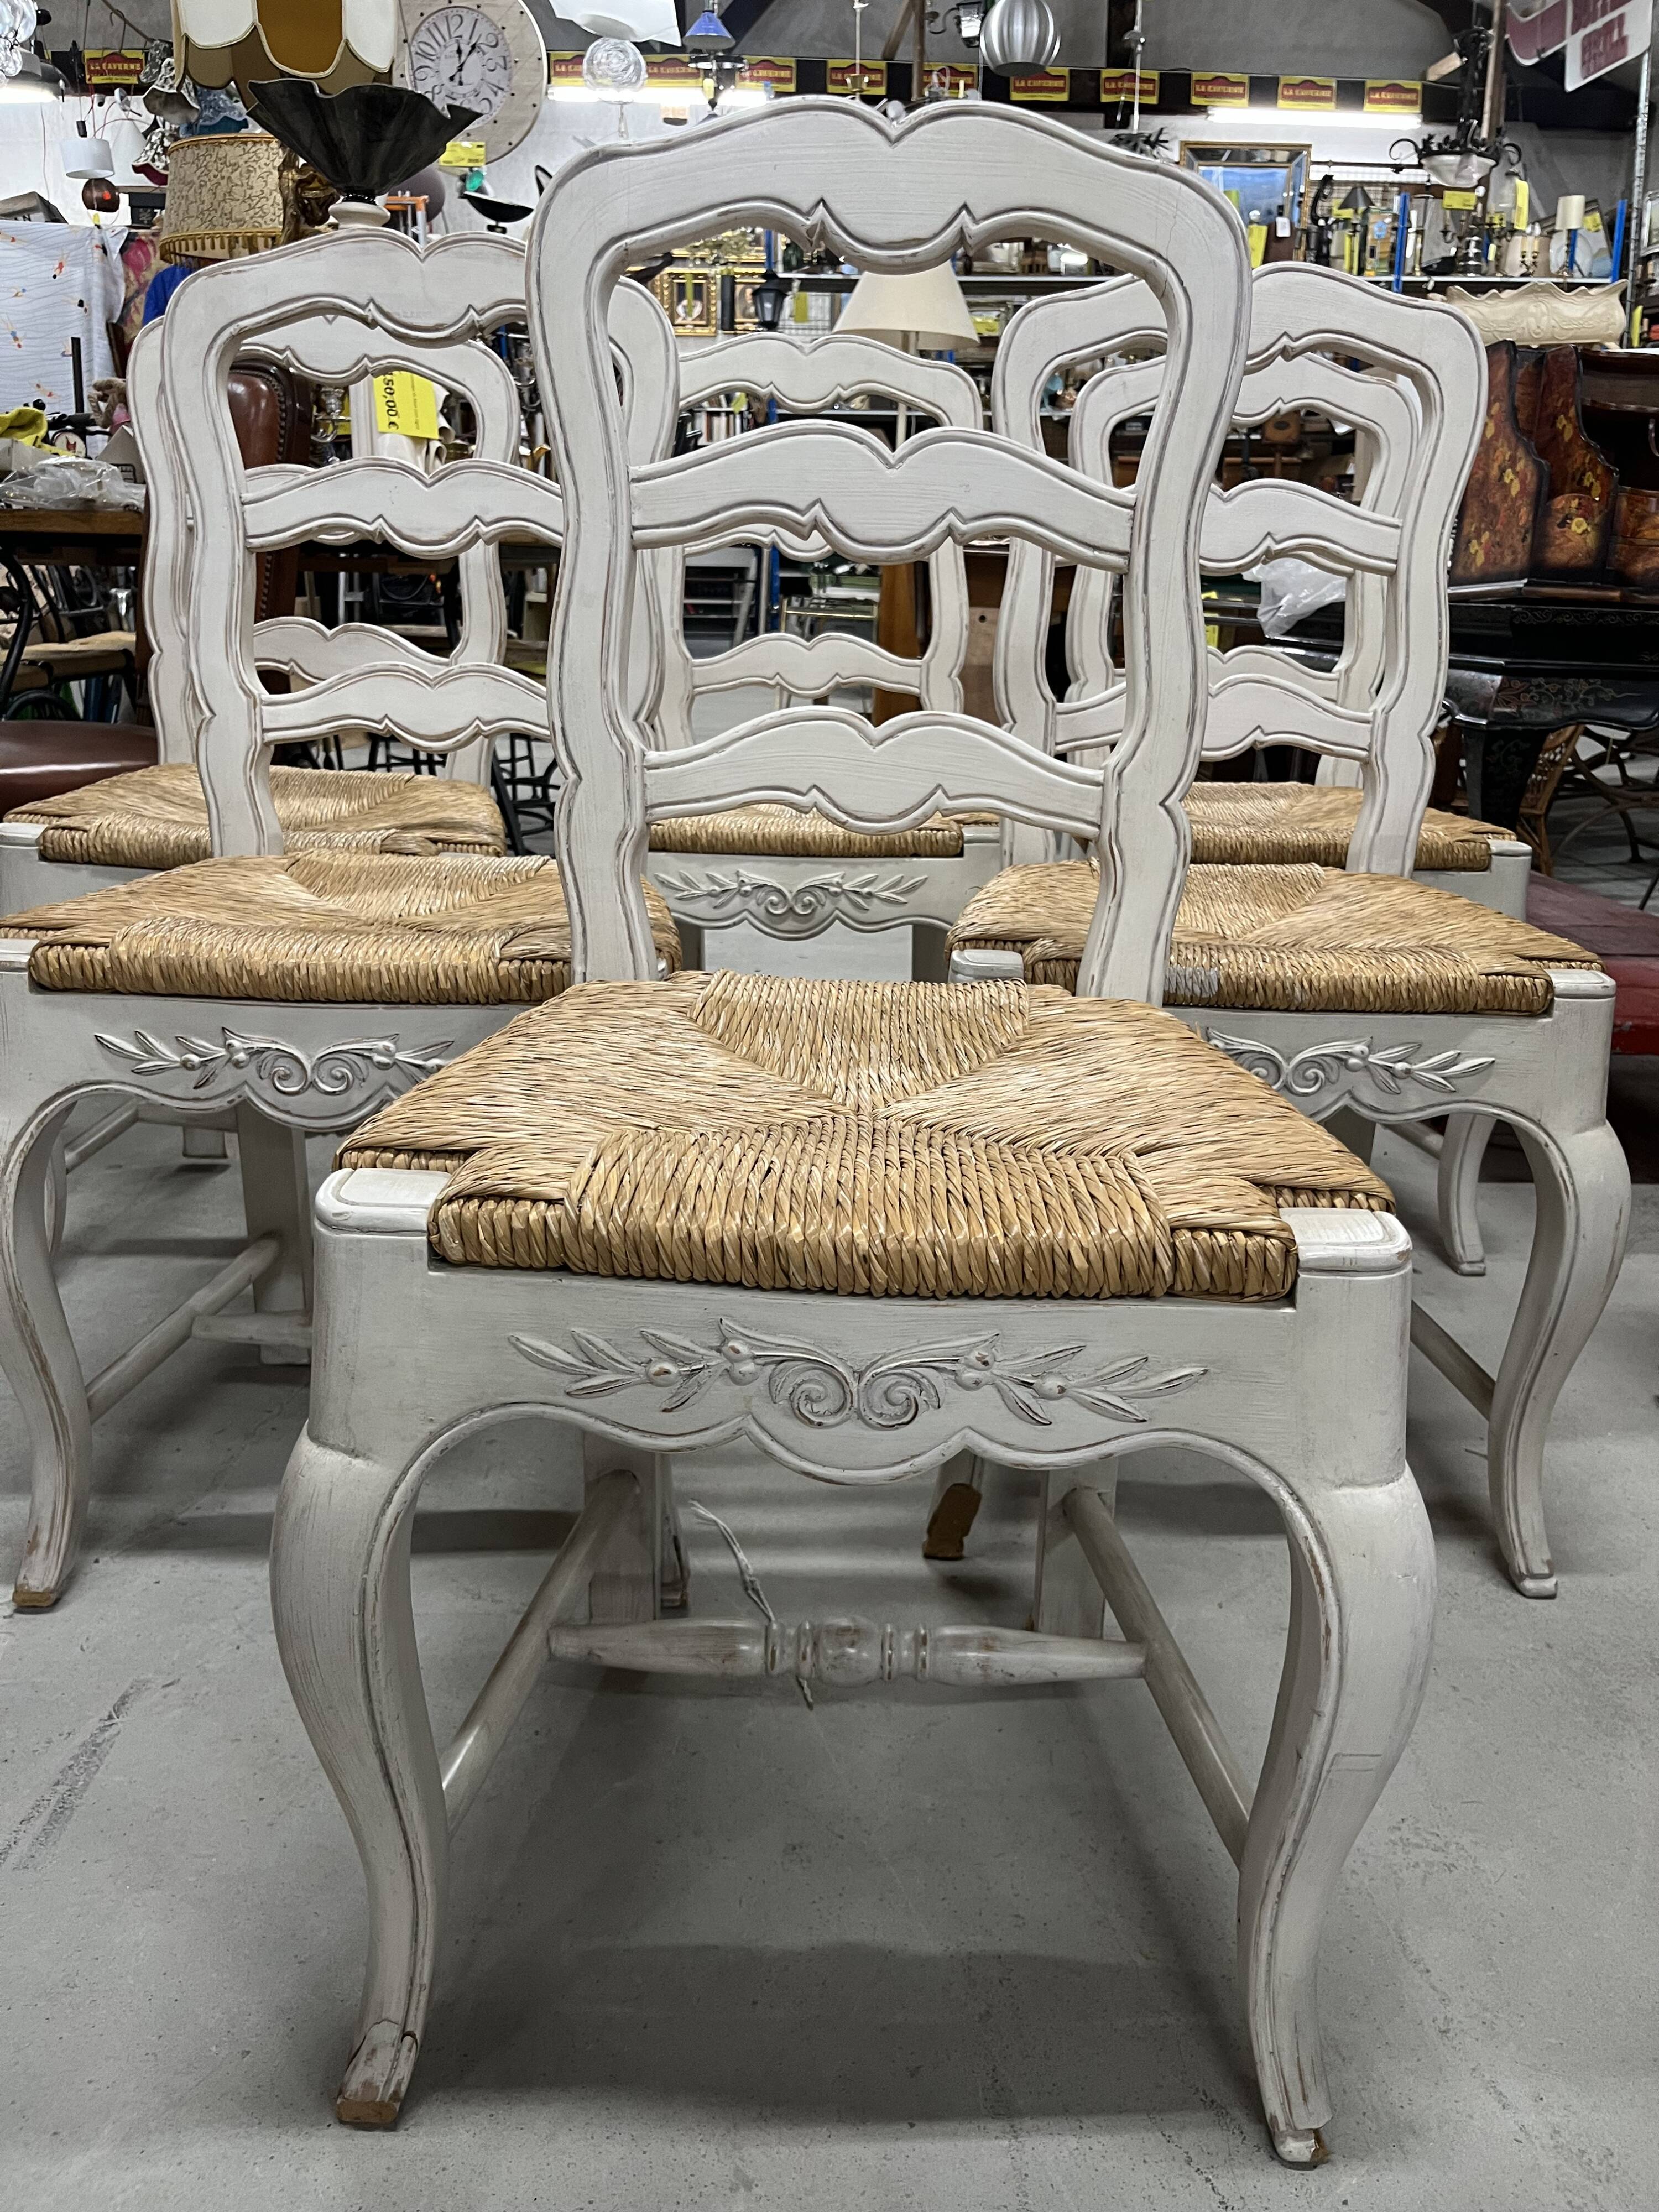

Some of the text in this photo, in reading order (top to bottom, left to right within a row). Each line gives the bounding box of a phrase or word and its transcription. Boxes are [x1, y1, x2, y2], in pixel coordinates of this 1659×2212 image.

[427, 22, 446, 46] 11
[444, 14, 463, 39] 12
[415, 41, 436, 61] 10
[477, 32, 499, 56] 2
[415, 65, 434, 81] 9
[485, 55, 507, 72] 3
[485, 81, 504, 97] 4
[382, 372, 399, 430] 50,00 €
